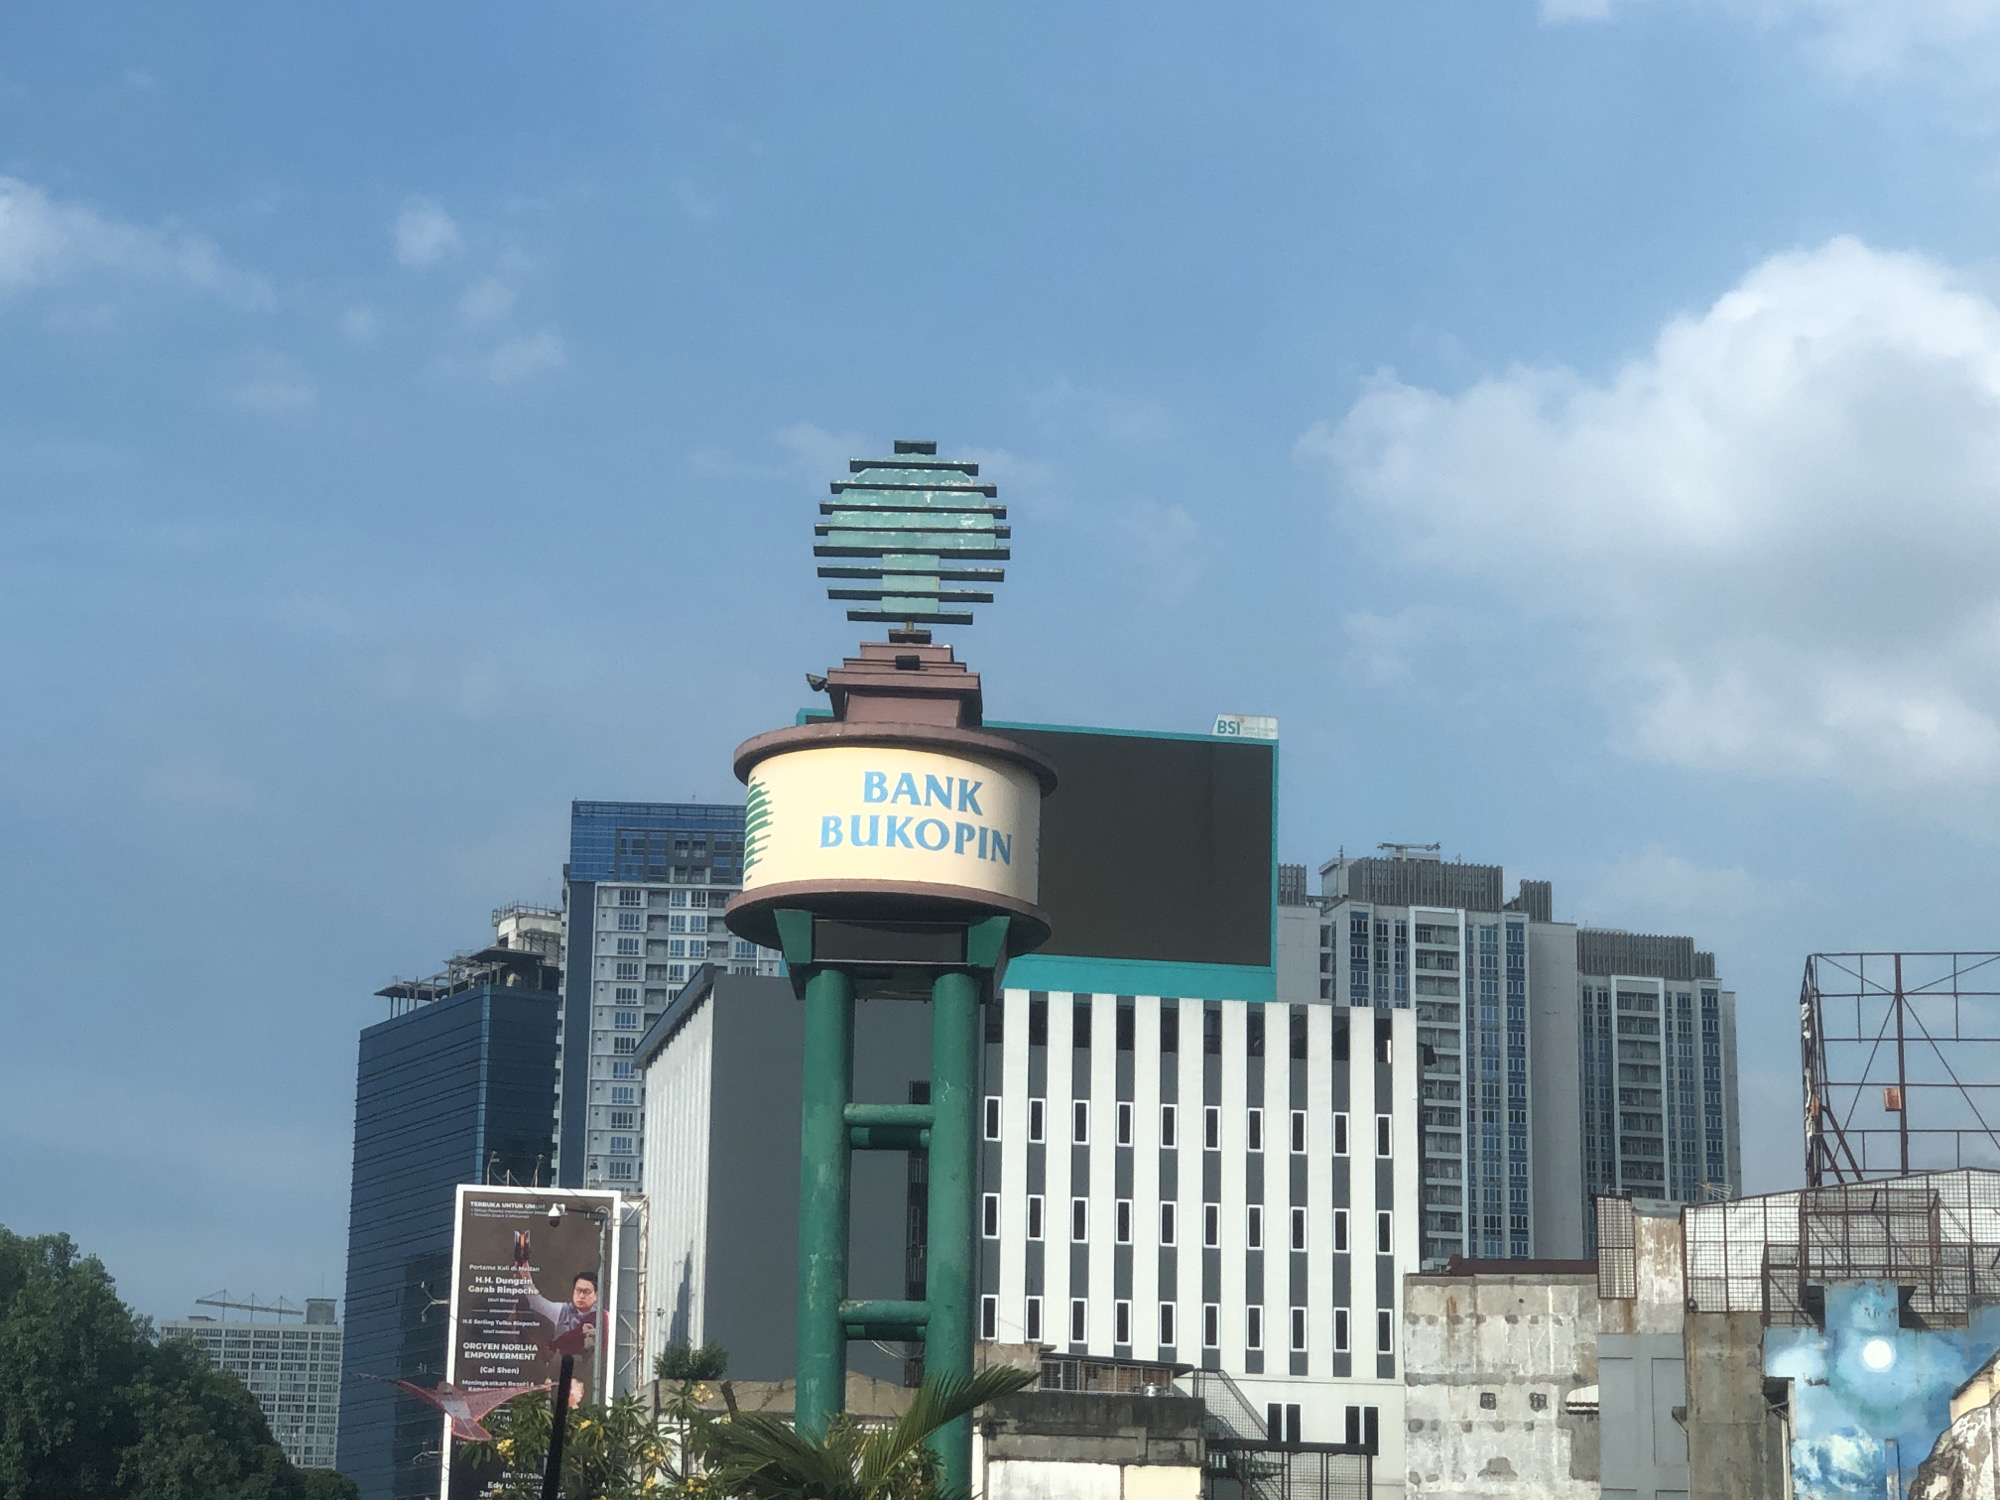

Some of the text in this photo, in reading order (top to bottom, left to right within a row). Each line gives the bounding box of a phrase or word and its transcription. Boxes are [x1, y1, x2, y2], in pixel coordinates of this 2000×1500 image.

[1217, 720, 1240, 735] BSI
[863, 771, 983, 816] BANK
[820, 814, 1012, 866] BUKOPIN
[475, 1276, 533, 1286] H.H. Dungzin
[468, 1285, 539, 1295] Garab Rinpoche
[463, 1342, 538, 1351] ORGYEN NORLHA
[464, 1351, 536, 1360] EMPOWERMENT
[480, 1366, 520, 1374] (Cai Shen)
